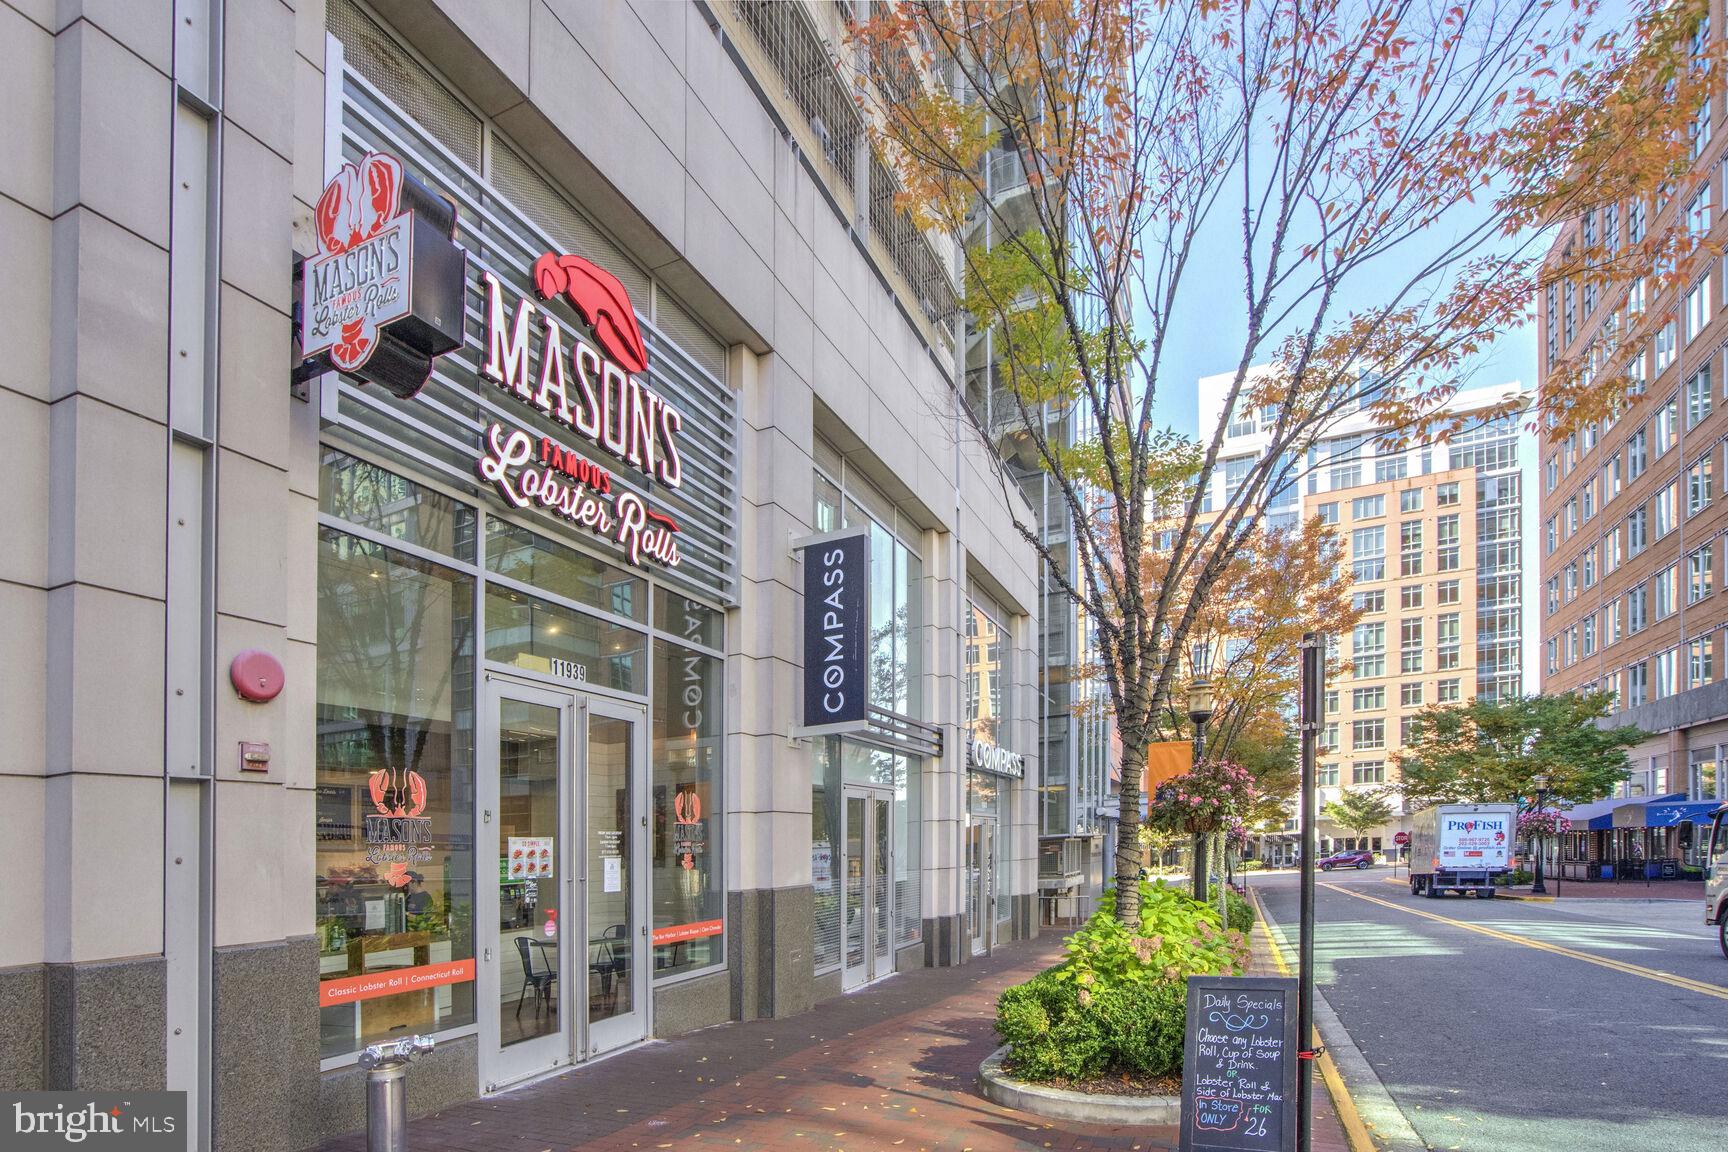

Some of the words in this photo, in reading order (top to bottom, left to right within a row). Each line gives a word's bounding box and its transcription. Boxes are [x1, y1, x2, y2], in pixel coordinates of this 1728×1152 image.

[312, 231, 400, 307] MASON'S
[331, 287, 362, 309] FAMOUS
[312, 303, 360, 337] Lobster
[364, 283, 400, 317] Rolls
[482, 270, 682, 488] MASON'S
[540, 436, 612, 495] FAMOUS
[479, 423, 613, 533] Lobster
[616, 491, 681, 567] Rolls
[823, 548, 845, 713] COMPASS
[552, 658, 586, 682] 11939
[975, 740, 1022, 777] COMPASS
[365, 818, 433, 844] MASON'S
[383, 844, 406, 852] FAMOUS
[328, 986, 357, 997] Classic
[359, 981, 387, 992] Lobster
[388, 978, 402, 987] Roll
[411, 970, 451, 983] Connecticut
[451, 968, 464, 976] Roll
[1203, 994, 1231, 1013] Daily
[1237, 994, 1283, 1013] Specials
[1198, 1027, 1229, 1043] Choose
[1232, 1036, 1247, 1049] any
[1251, 1034, 1284, 1048] Lobster
[1216, 1059, 1224, 1068] &
[1222, 1047, 1240, 1061] Cup
[1242, 1047, 1253, 1058] of
[1256, 1049, 1280, 1061] Soup
[1196, 1073, 1233, 1088] Lobster
[1238, 1078, 1257, 1090] Roll
[1261, 1081, 1271, 1091] &
[1220, 1088, 1231, 1098] of
[1233, 1088, 1264, 1100] Lobster
[1199, 1100, 1207, 1109] In
[1211, 1100, 1239, 1112] Store
[1200, 1113, 1227, 1125] ONLY
[1244, 1117, 1267, 1137] 26
